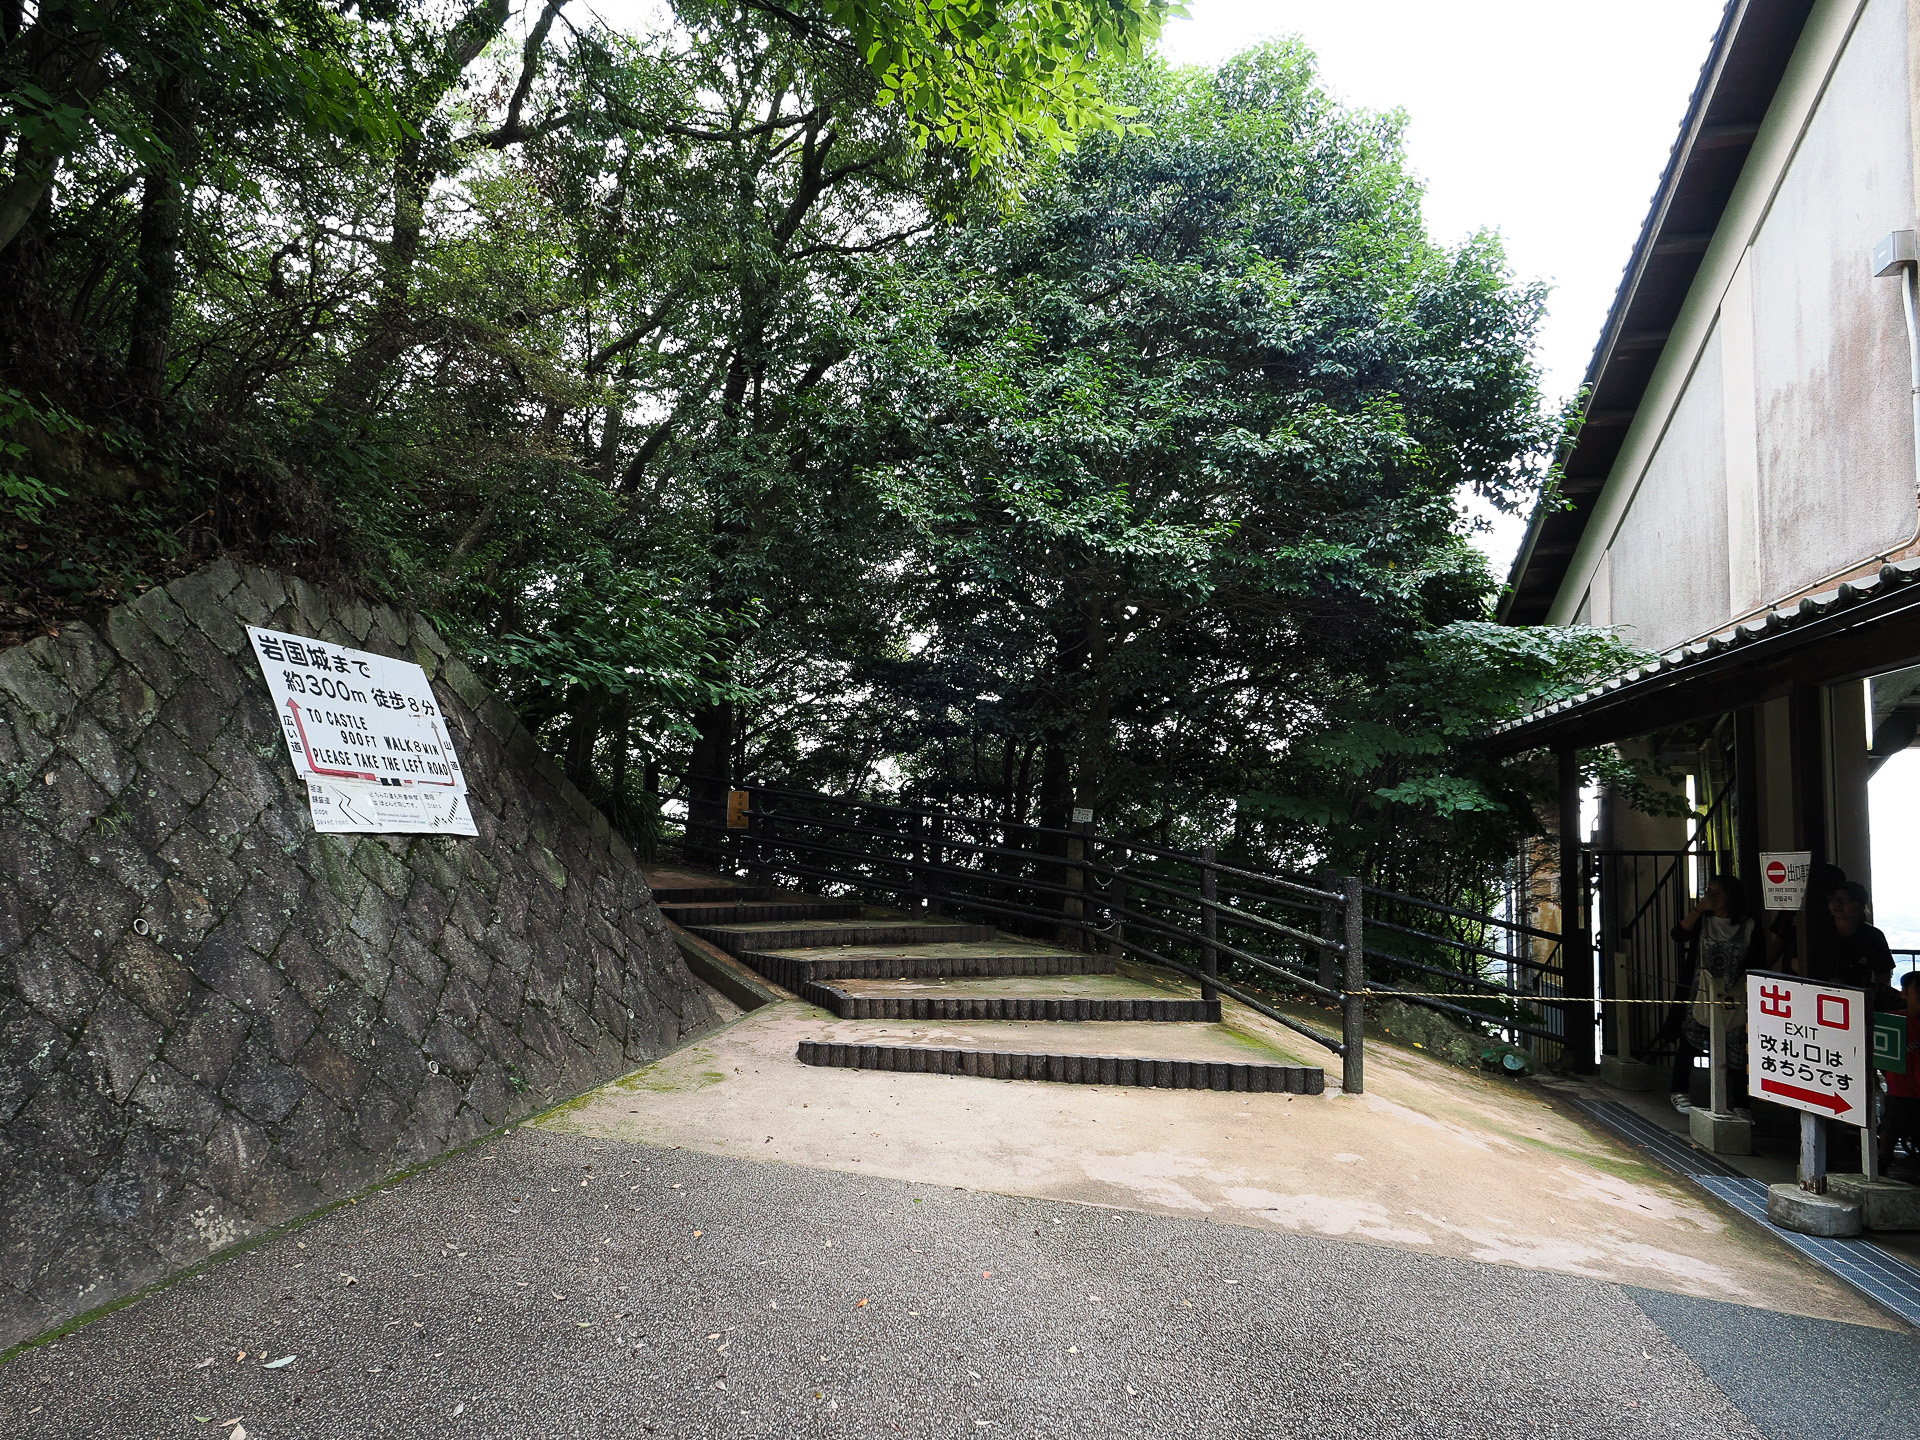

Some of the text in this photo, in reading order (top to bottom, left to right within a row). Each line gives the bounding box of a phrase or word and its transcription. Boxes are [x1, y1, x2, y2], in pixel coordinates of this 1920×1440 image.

[258, 634, 371, 679] 岩国城まで
[283, 670, 435, 717] 約300m 徒歩8分
[283, 715, 303, 754] 広い道
[306, 708, 368, 731] TO CASTLE
[312, 747, 449, 776] PLEASE TAKE THE LEFT ROAD
[1785, 1022, 1819, 1041] EXIT
[1760, 1033, 1844, 1068] 改札口は
[1761, 1055, 1854, 1091] あちらです
